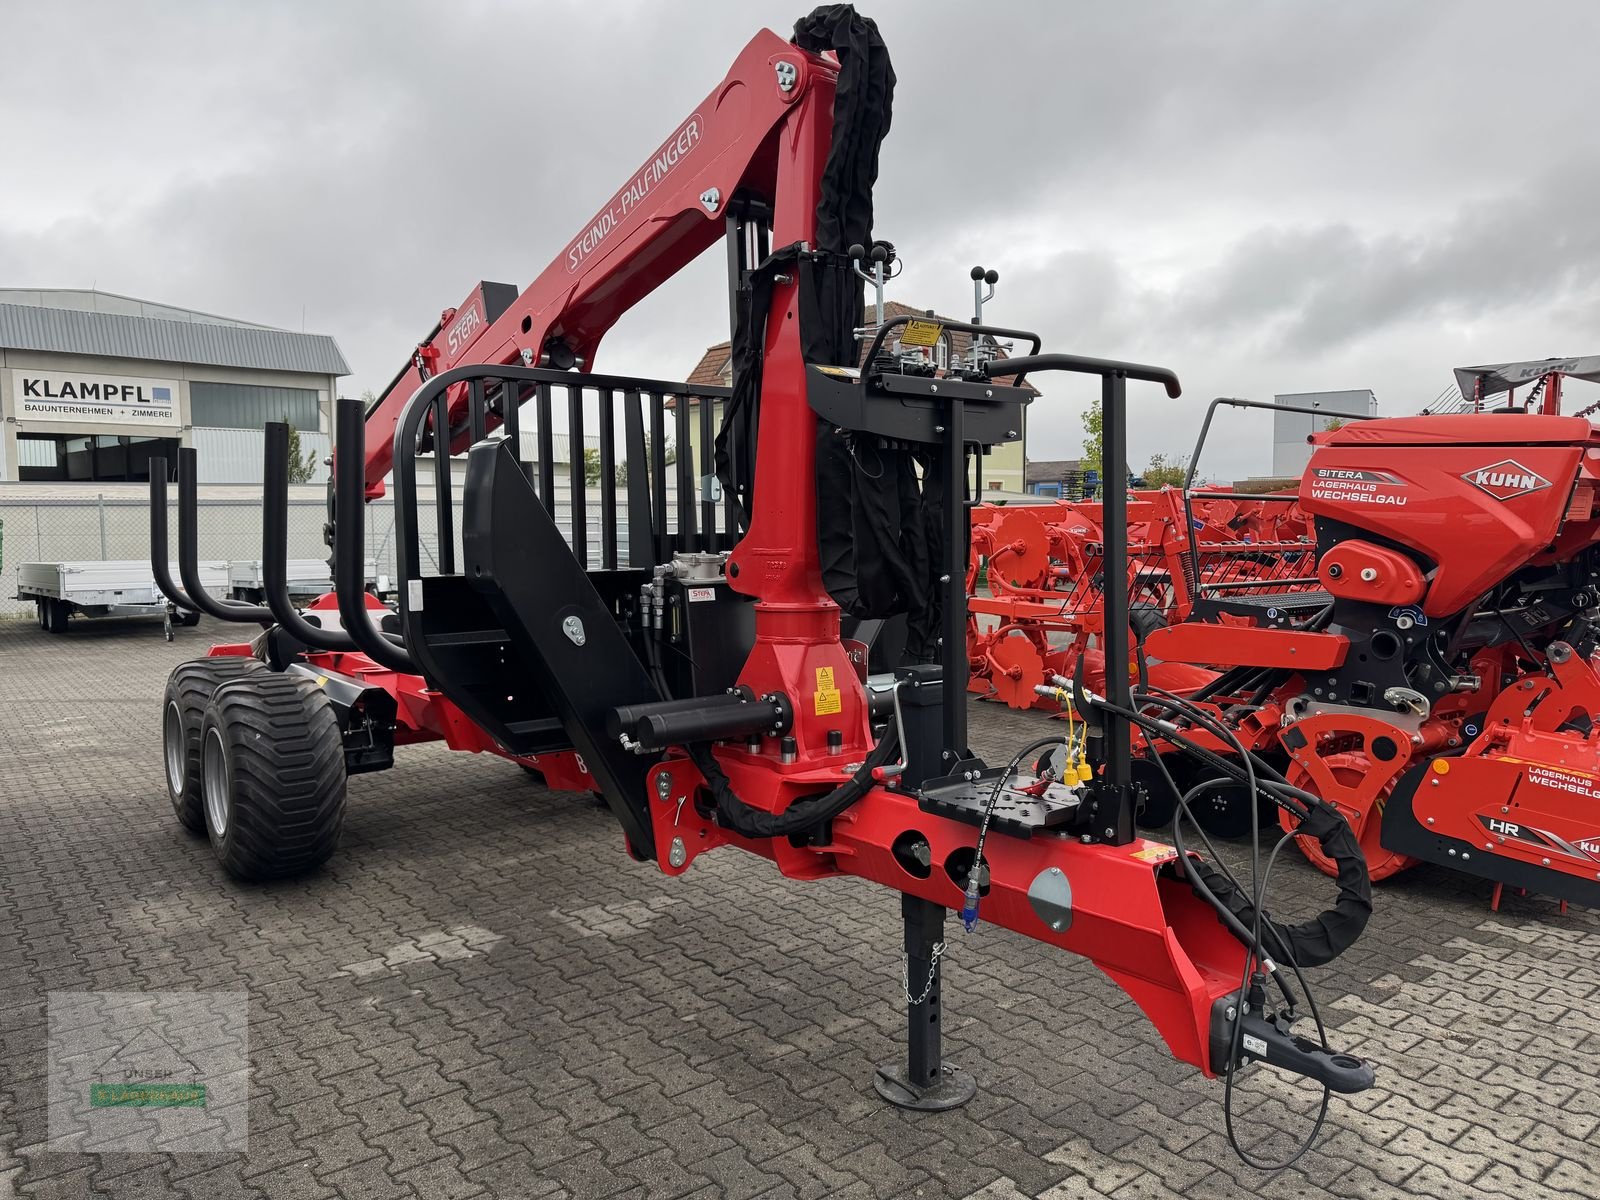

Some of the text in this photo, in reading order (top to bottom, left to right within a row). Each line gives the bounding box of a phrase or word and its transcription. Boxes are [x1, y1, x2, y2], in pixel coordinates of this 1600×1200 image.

[568, 120, 699, 270] STEINDL-PALFINGER
[448, 309, 480, 355] STEPA
[23, 378, 150, 403] KLAMPFL
[24, 404, 113, 415] BAUUNTERNEHMEN
[131, 409, 173, 418] ZIMMEREI
[1318, 469, 1363, 480] SITERA
[1475, 471, 1537, 489] KUHN
[1312, 480, 1377, 492] LAGERHAUS
[1311, 489, 1407, 506] WECHSELGAU
[1528, 766, 1593, 787] LAGERHAUS
[1528, 774, 1600, 799] WECHSELG
[1489, 819, 1519, 837] HR
[1580, 841, 1600, 853] KU
